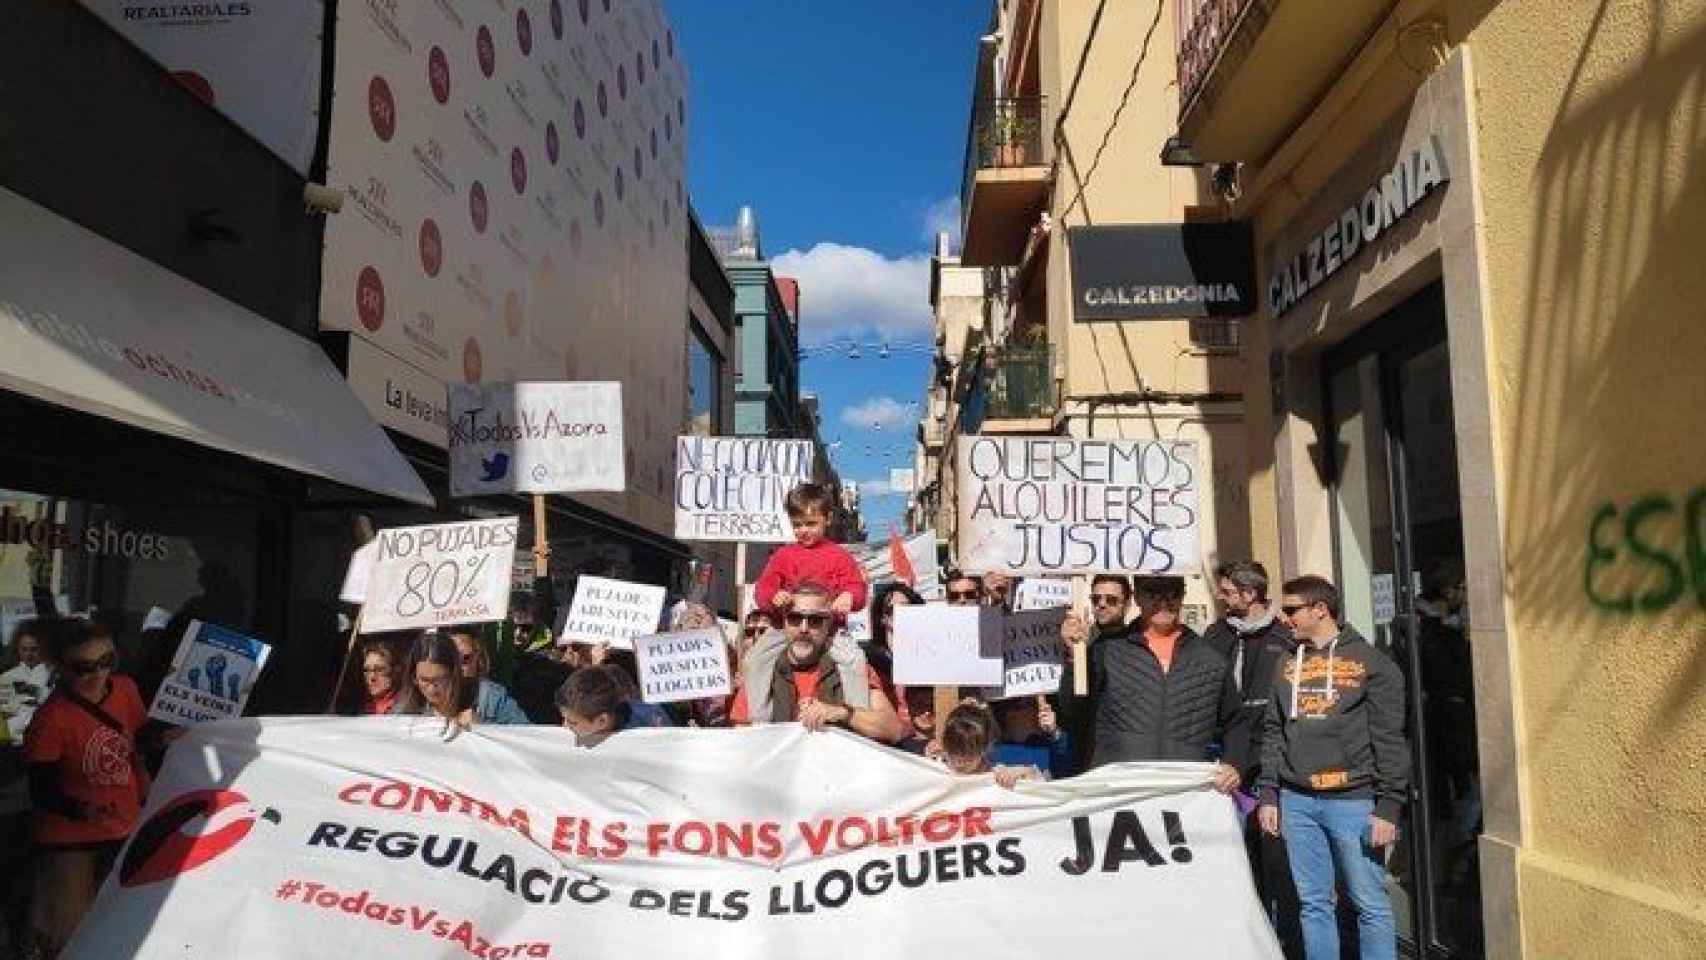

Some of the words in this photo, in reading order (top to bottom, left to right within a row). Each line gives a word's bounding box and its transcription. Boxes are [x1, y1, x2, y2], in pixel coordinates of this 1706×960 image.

[1268, 135, 1450, 319] CALZEDONIA
[1085, 284, 1240, 304] CALZEDONIA
[385, 380, 402, 409] La
[970, 437, 1193, 488] QUEREMOS
[970, 481, 1195, 528] ALQUILERES
[377, 530, 414, 562] NO
[1008, 523, 1175, 573] JUSTOS
[397, 552, 491, 617] 80%
[648, 639, 713, 657] PUJADES
[649, 657, 720, 675] ABUSIVES
[164, 683, 191, 700] ELS
[646, 674, 726, 695] LLOGUERS
[551, 816, 628, 858] ELS
[646, 820, 784, 860] FONS
[800, 806, 995, 857] VOLTOR
[308, 821, 611, 904] REGULACIÓ
[629, 888, 750, 921] DELS
[768, 837, 1027, 917] LLOGUERS
[1059, 809, 1193, 876] JA!
[275, 878, 551, 960] #TodasVsAzora
